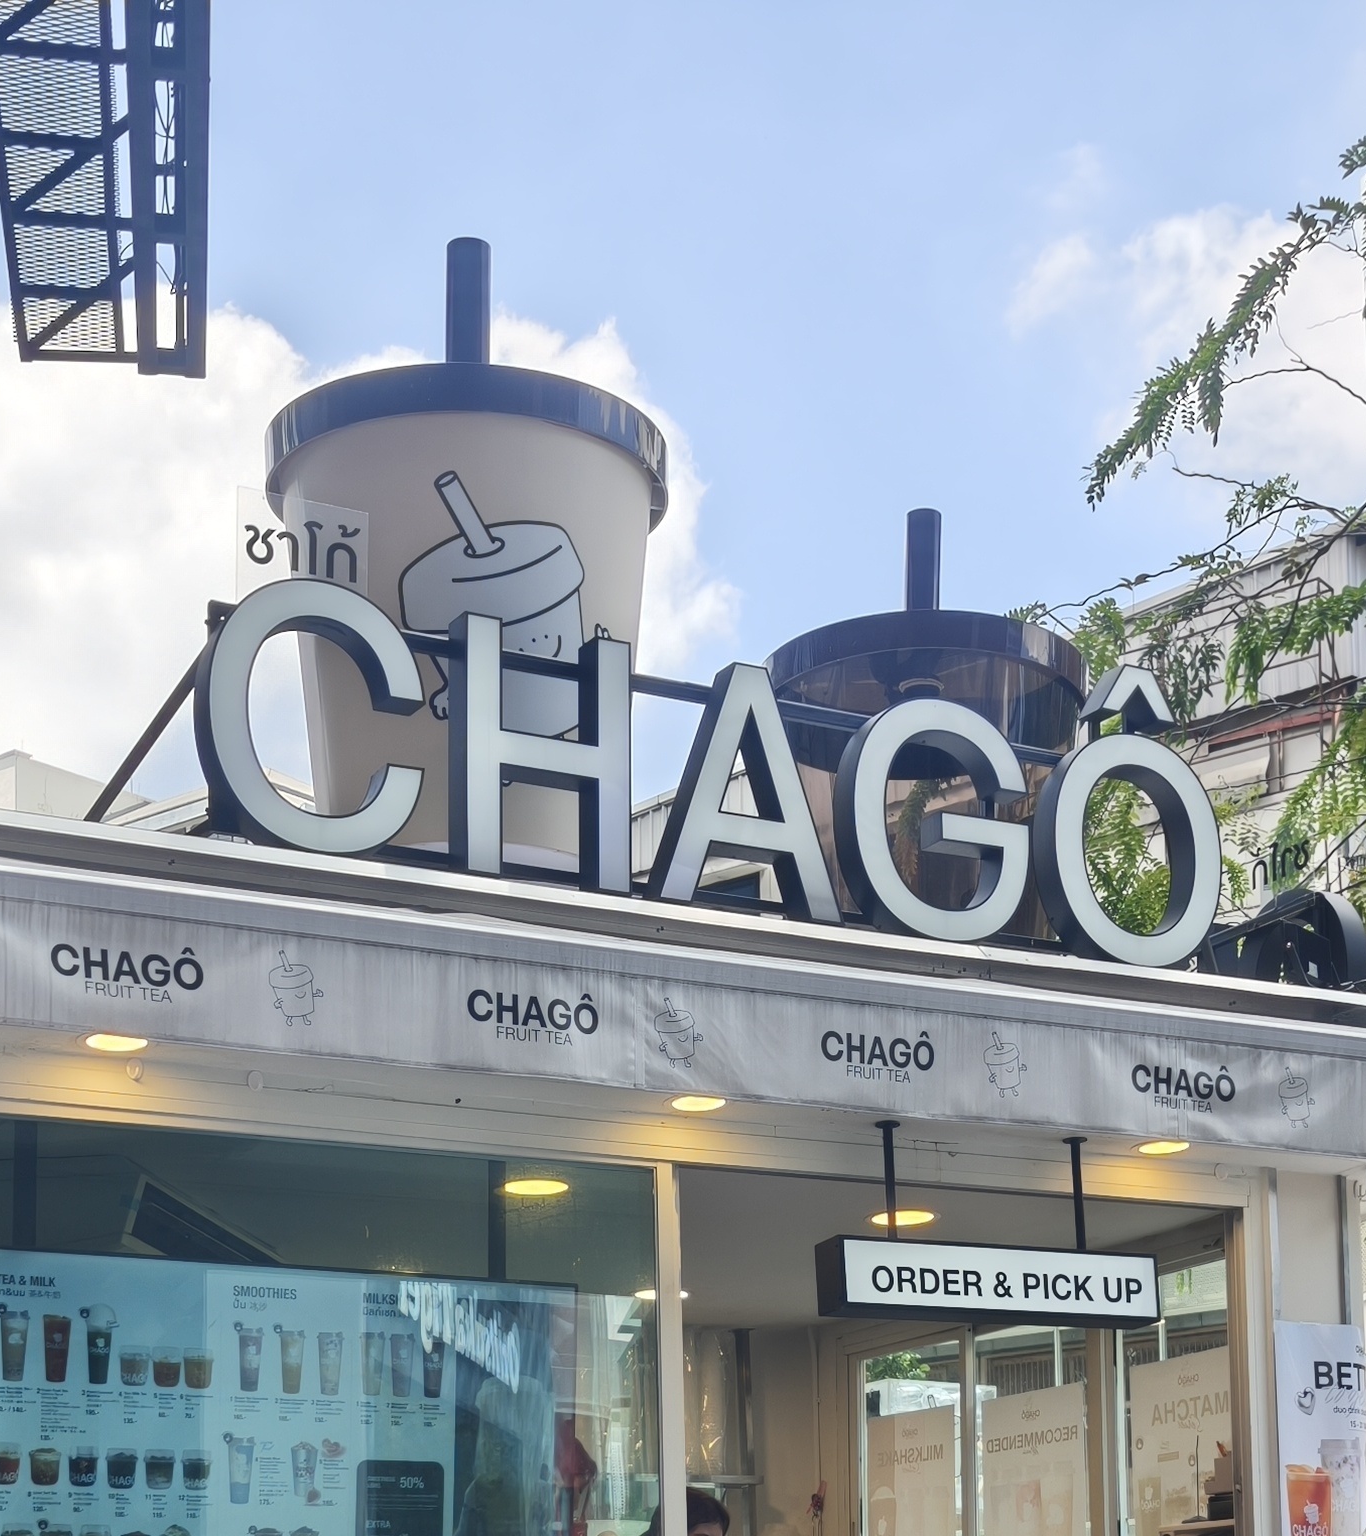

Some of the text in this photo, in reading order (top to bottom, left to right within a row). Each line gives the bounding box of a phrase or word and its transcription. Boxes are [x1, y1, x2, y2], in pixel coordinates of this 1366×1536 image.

[244, 520, 358, 584] ชาโก้
[197, 577, 1223, 968] CHAGÔ
[50, 942, 205, 991] CHAGÔ
[85, 980, 173, 1003] FRUIT TEA
[467, 989, 599, 1034] CHAGÔ
[496, 1025, 574, 1046] FRUIT TEA
[821, 1031, 935, 1071] CHAGÔ
[846, 1063, 912, 1084] FRUIT TEA
[1132, 1064, 1235, 1103] CHAGÔ
[1154, 1095, 1214, 1114] FRUIT TEA
[18, 1276, 27, 1286] &
[29, 1276, 56, 1287] MILK
[233, 1285, 297, 1300] SMOOTHIES
[871, 1265, 1143, 1304] ORDER & PICK UP
